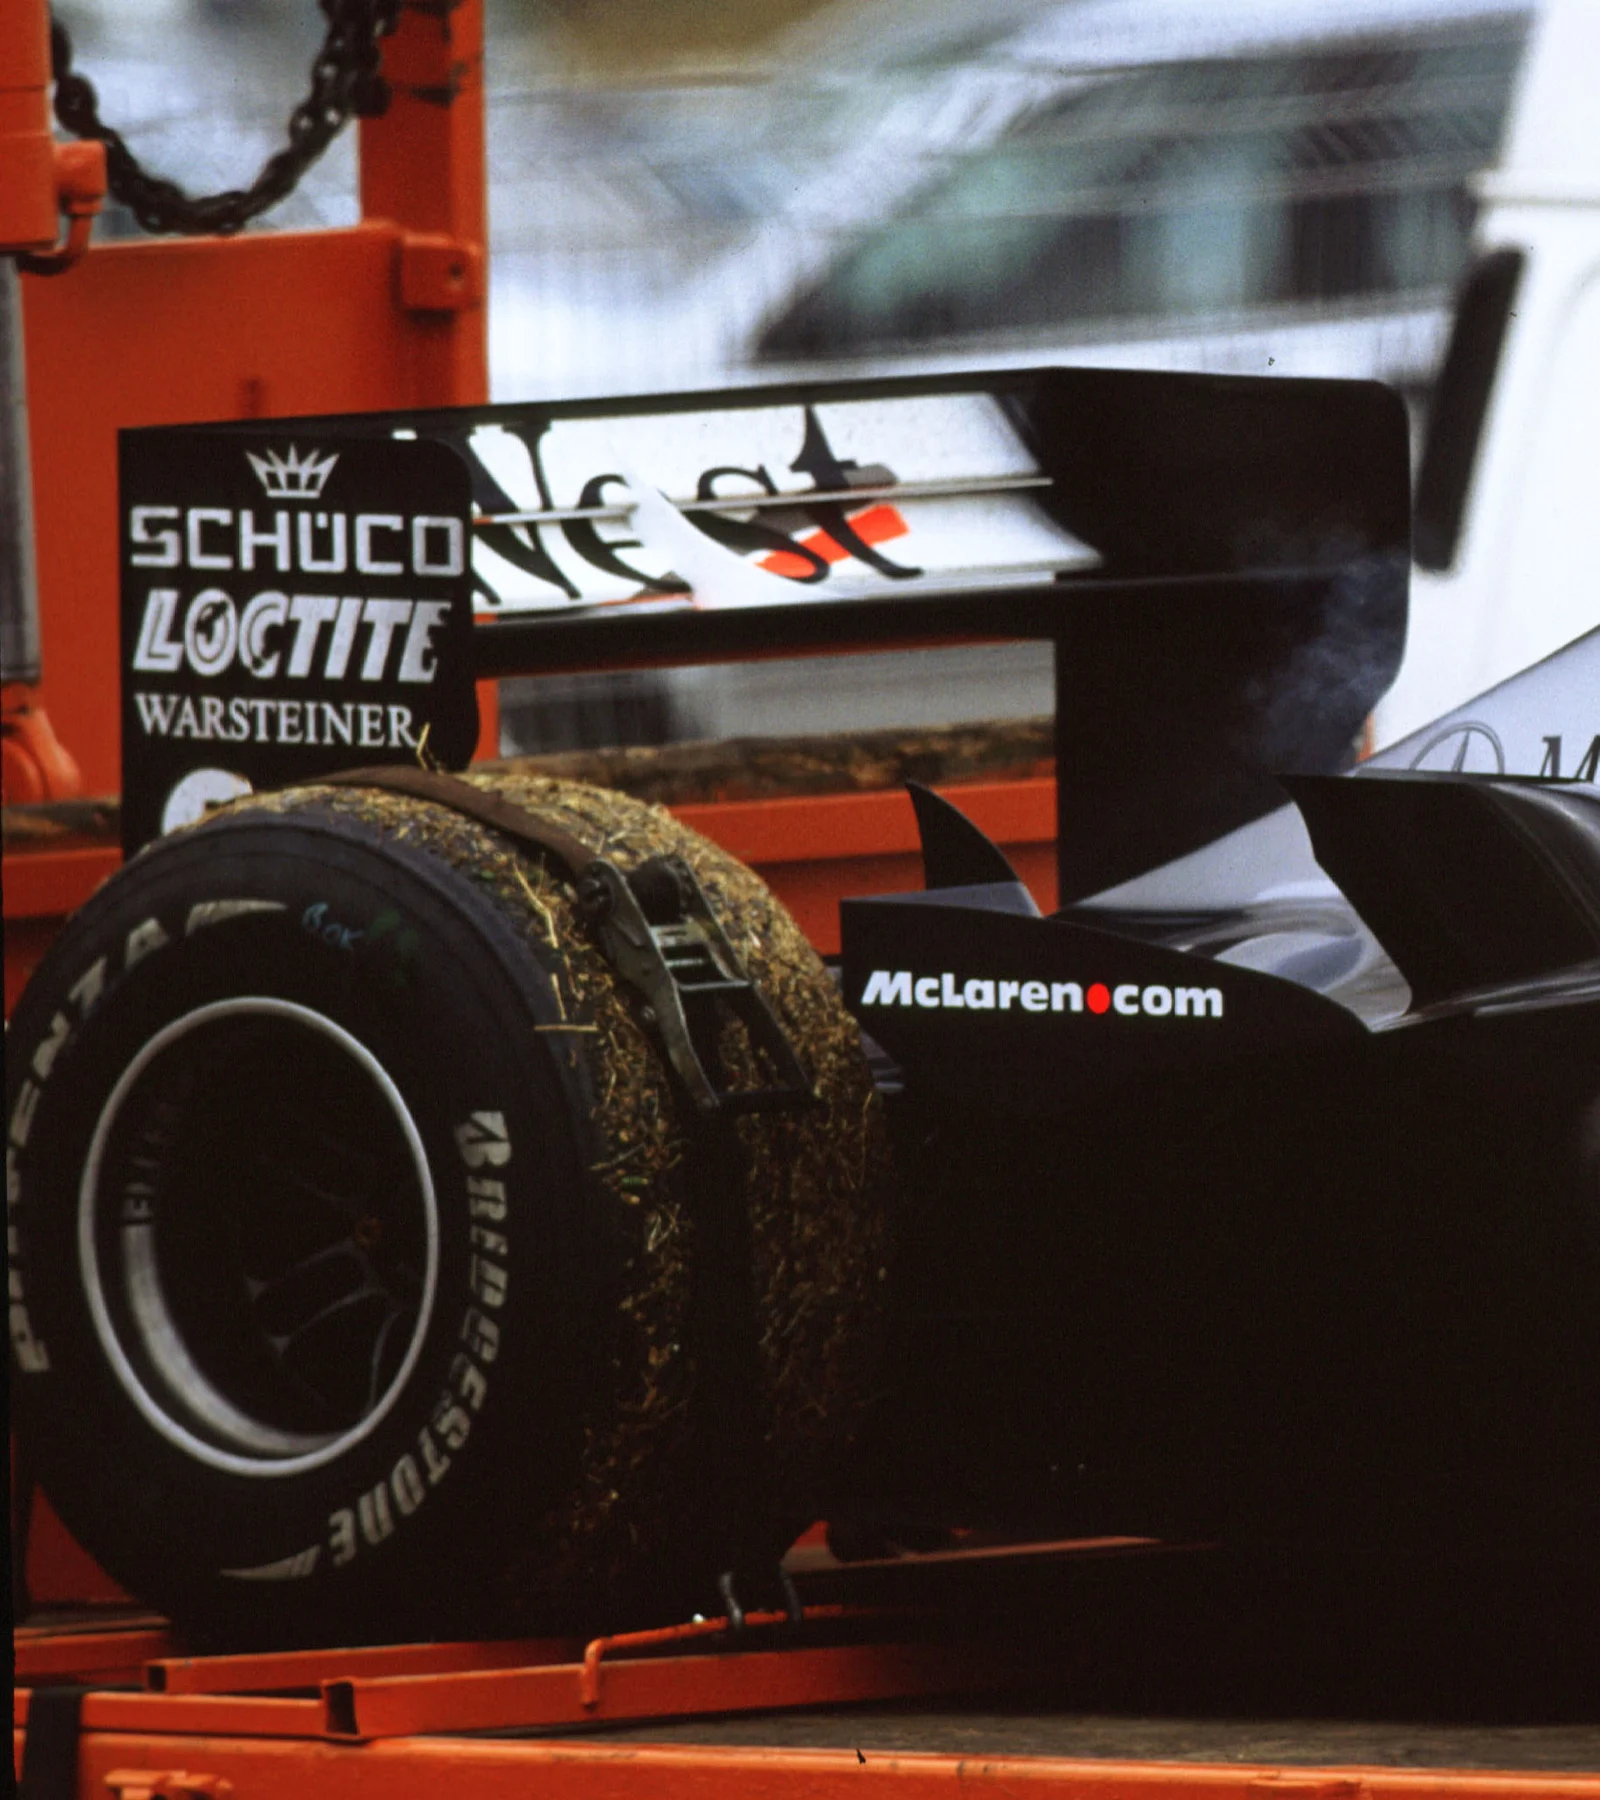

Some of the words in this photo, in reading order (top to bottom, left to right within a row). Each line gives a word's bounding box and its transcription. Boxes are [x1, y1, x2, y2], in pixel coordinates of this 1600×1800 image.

[130, 506, 465, 577] SCHÜCO
[133, 587, 453, 684] LOCTITE
[134, 692, 419, 748] WARSTEINER
[861, 970, 1224, 1018] McLaren.com
[330, 1110, 512, 1567] BRIDGESTONE
